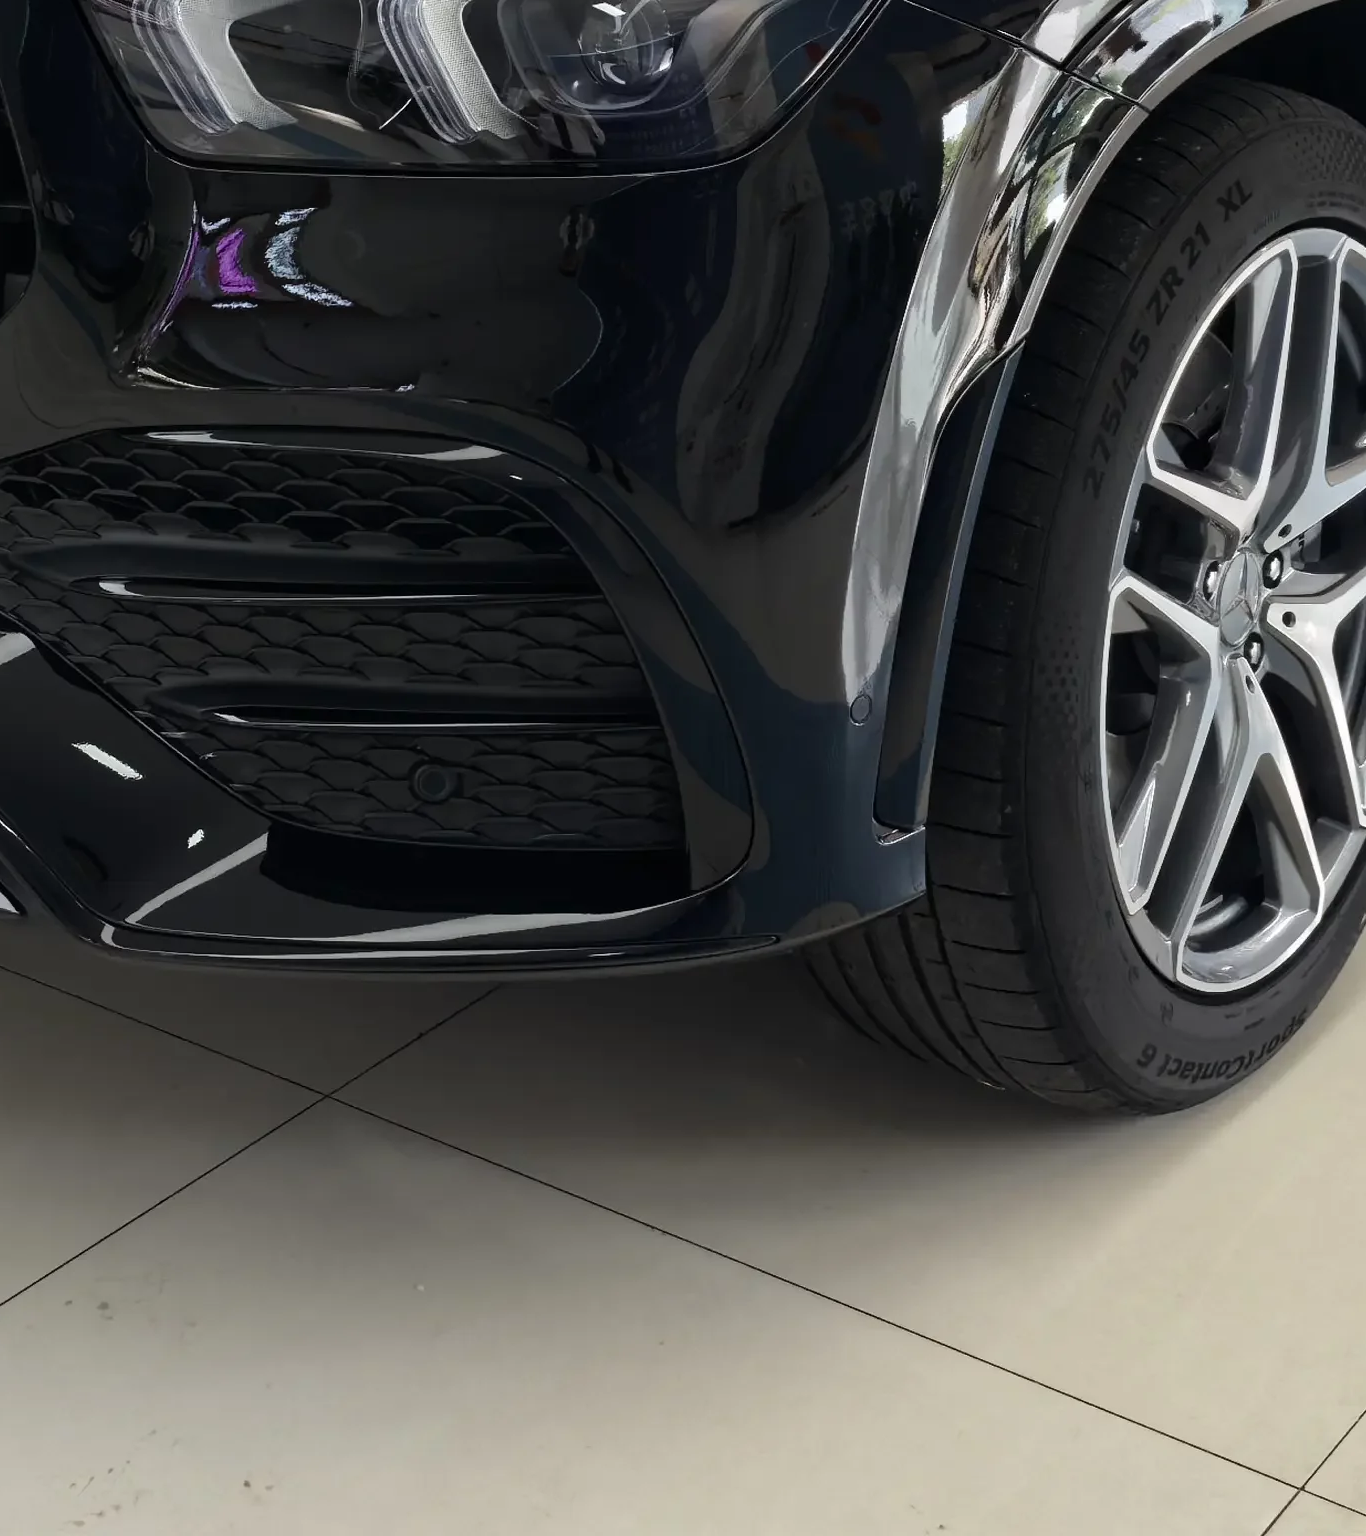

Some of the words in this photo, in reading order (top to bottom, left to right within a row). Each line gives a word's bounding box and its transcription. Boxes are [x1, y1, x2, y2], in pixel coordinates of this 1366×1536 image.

[1084, 328, 1151, 500] 275/45
[1145, 265, 1185, 327] ZR
[1179, 220, 1212, 271] 21
[1215, 178, 1254, 223] XL
[1136, 1042, 1158, 1069] 6
